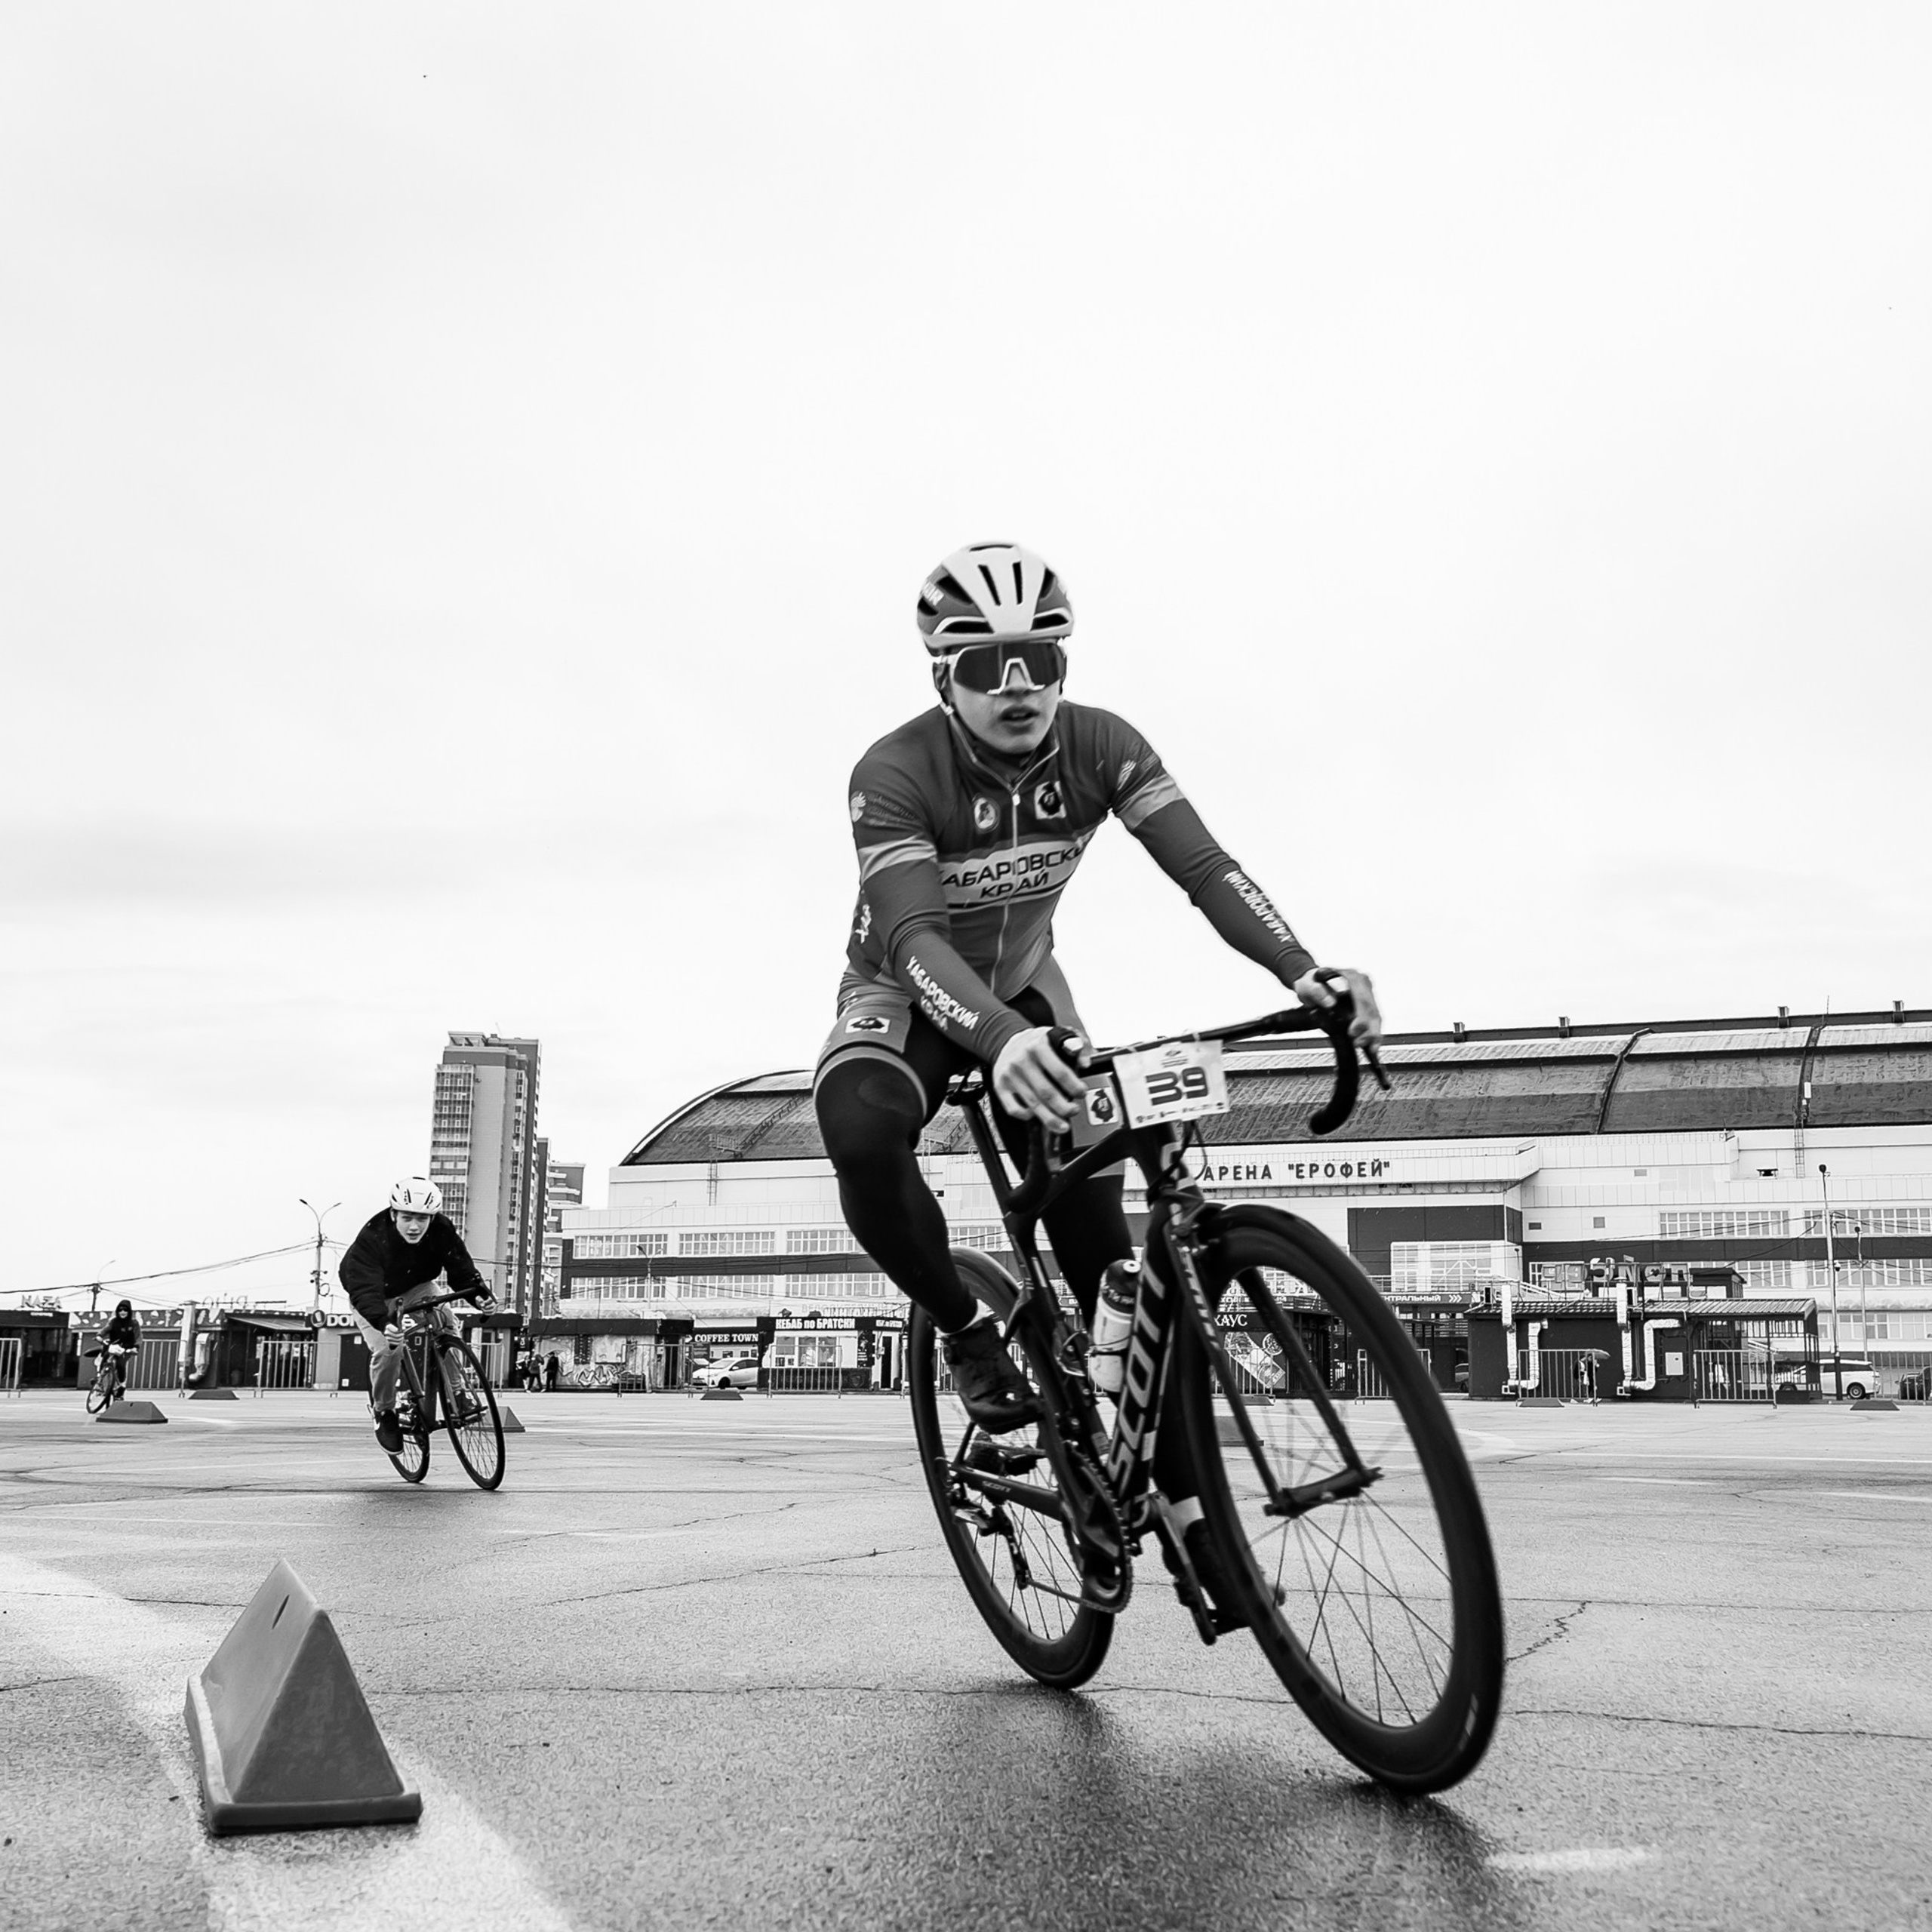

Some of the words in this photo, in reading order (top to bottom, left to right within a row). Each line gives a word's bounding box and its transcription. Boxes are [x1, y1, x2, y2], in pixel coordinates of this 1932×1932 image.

[980, 869, 1049, 898] КРАЙ
[906, 955, 980, 1030] ХАБАРОВСКИЙ
[1146, 1066, 1209, 1106] 39
[1203, 1164, 1272, 1181] АРЕНА
[1288, 1158, 1390, 1180] "ЕРОФЕЙ"
[694, 1334, 729, 1343] COFFEE
[732, 1334, 758, 1342] TOWN
[775, 1319, 802, 1330] КЕБАБ
[817, 1318, 856, 1329] БРАТСКИ
[1107, 1249, 1165, 1498] SCOTT
